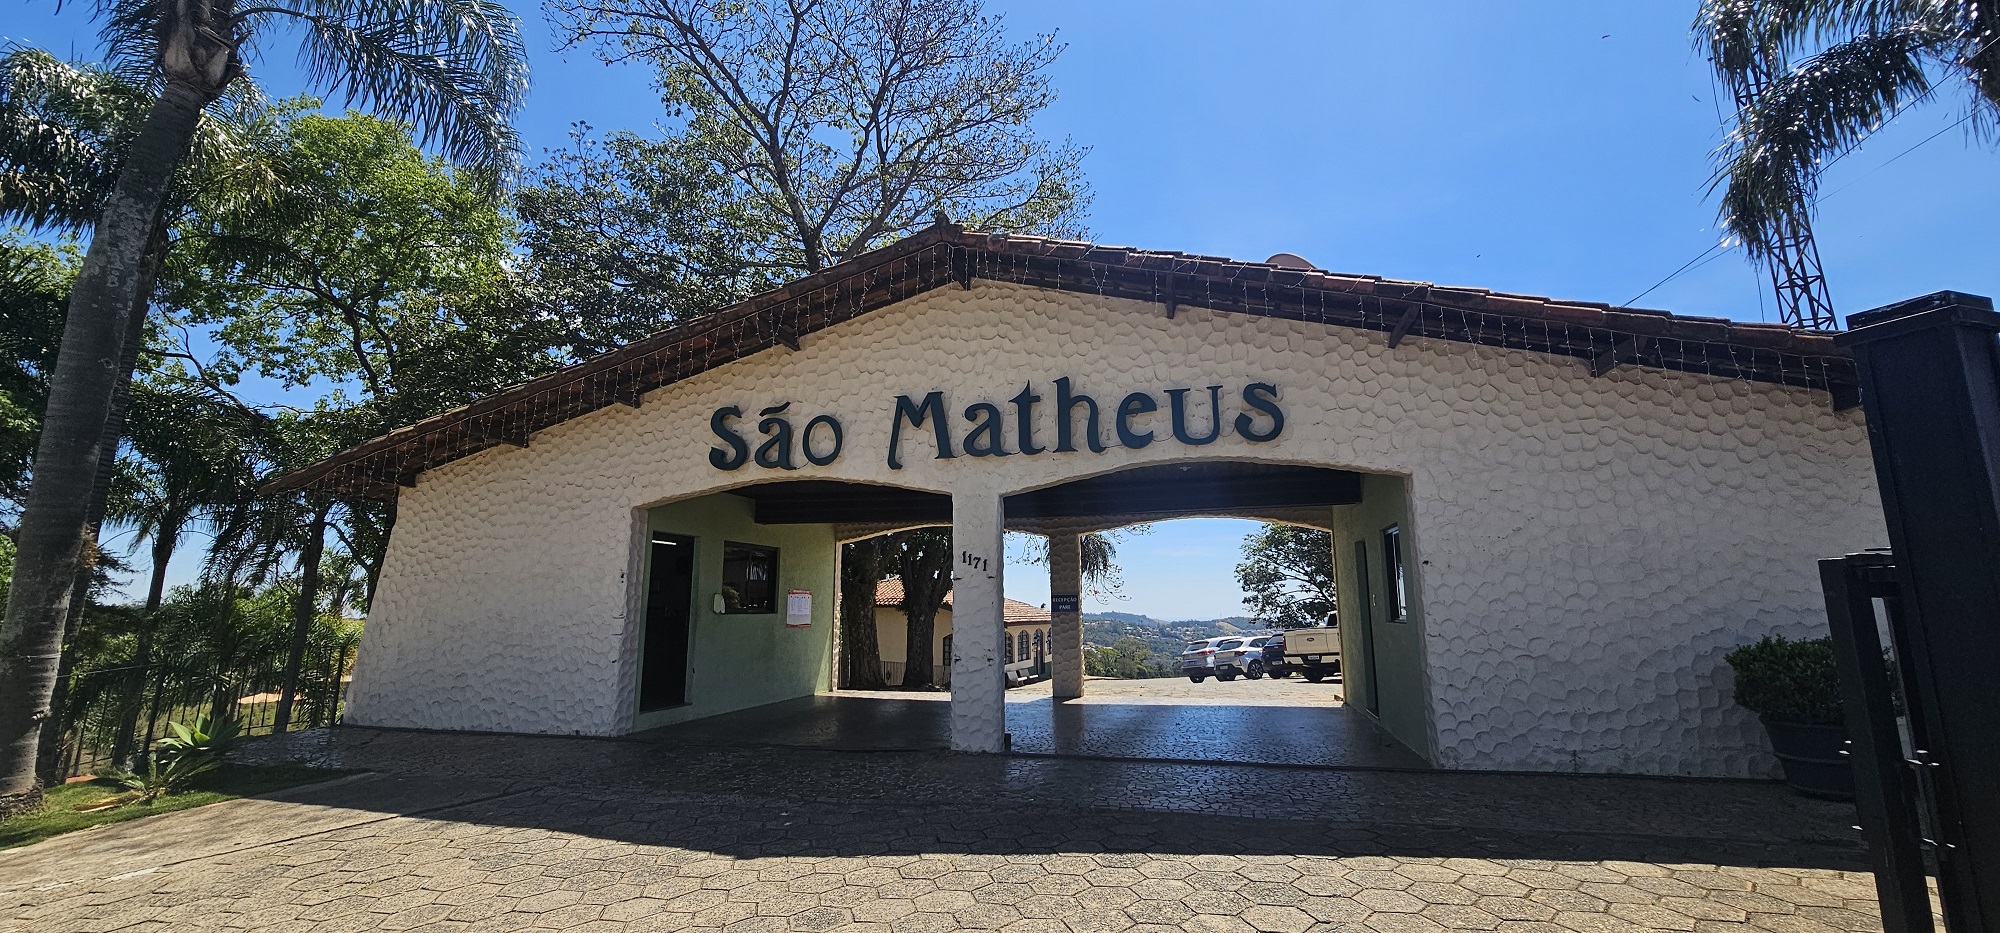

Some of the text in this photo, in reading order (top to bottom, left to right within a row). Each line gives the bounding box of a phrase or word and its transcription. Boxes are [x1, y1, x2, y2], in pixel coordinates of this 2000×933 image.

[709, 376, 1285, 470] São Matheus
[961, 551, 987, 572] 1171
